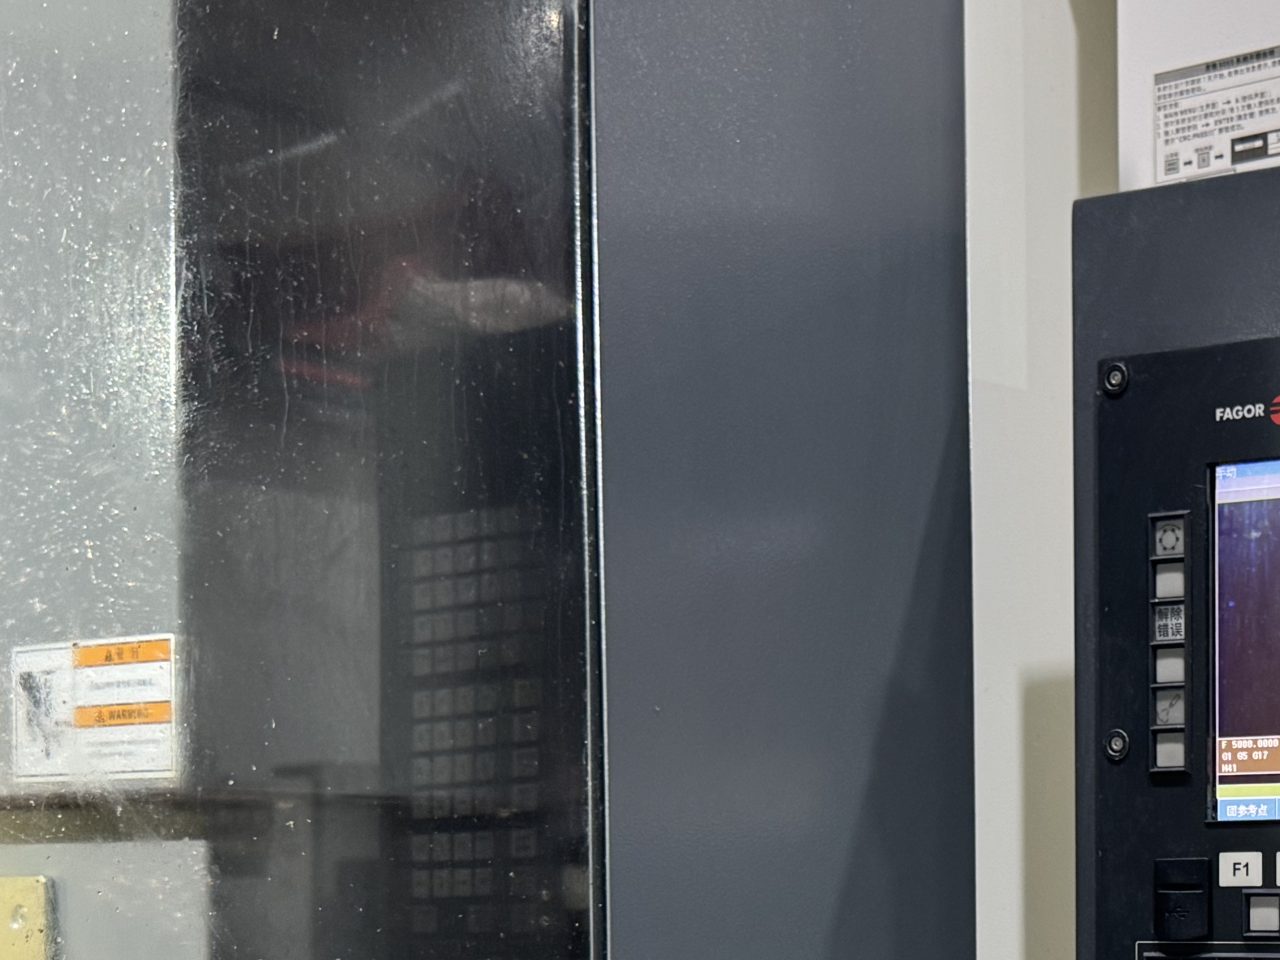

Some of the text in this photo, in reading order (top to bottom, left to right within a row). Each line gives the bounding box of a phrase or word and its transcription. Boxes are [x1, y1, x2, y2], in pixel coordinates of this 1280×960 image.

[1216, 404, 1264, 421] FAGOR
[1252, 751, 1268, 759] G17
[1233, 862, 1248, 876] F1
